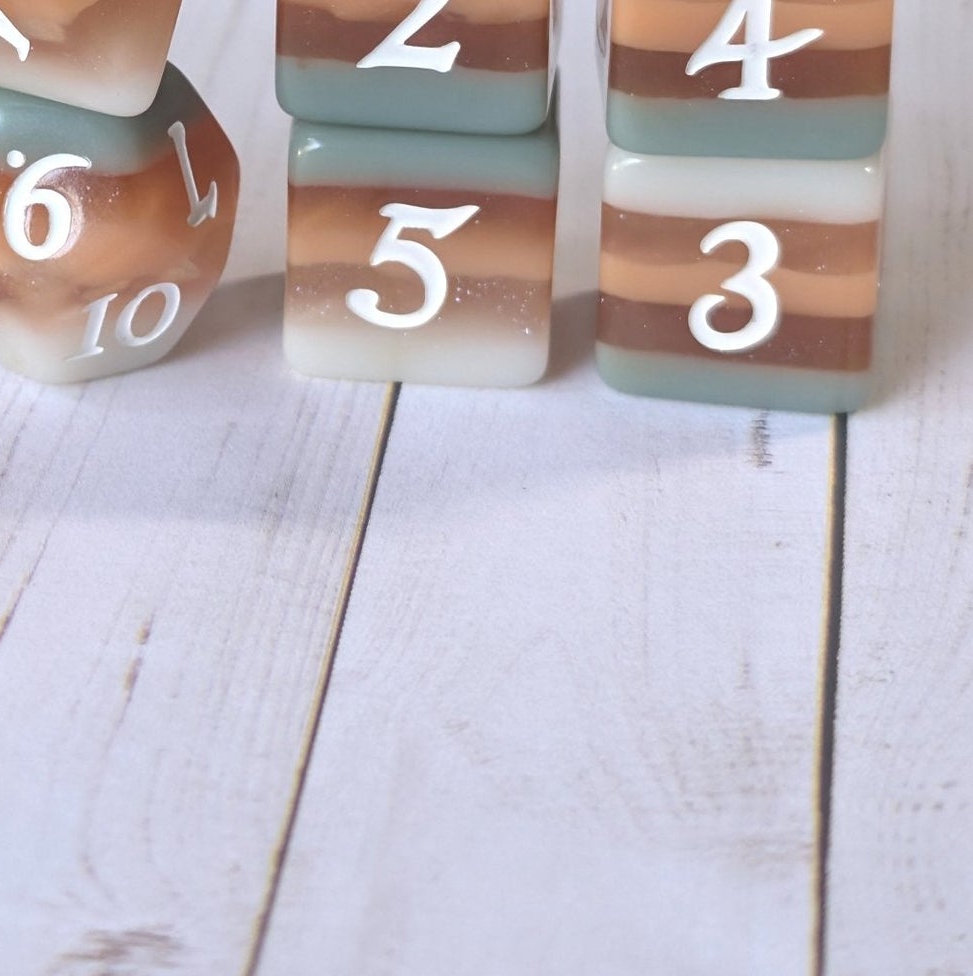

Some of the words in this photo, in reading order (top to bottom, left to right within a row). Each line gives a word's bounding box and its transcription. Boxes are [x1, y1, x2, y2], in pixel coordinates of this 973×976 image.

[67, 282, 180, 362] 10
[345, 202, 480, 328] 5
[687, 221, 780, 352] 3
